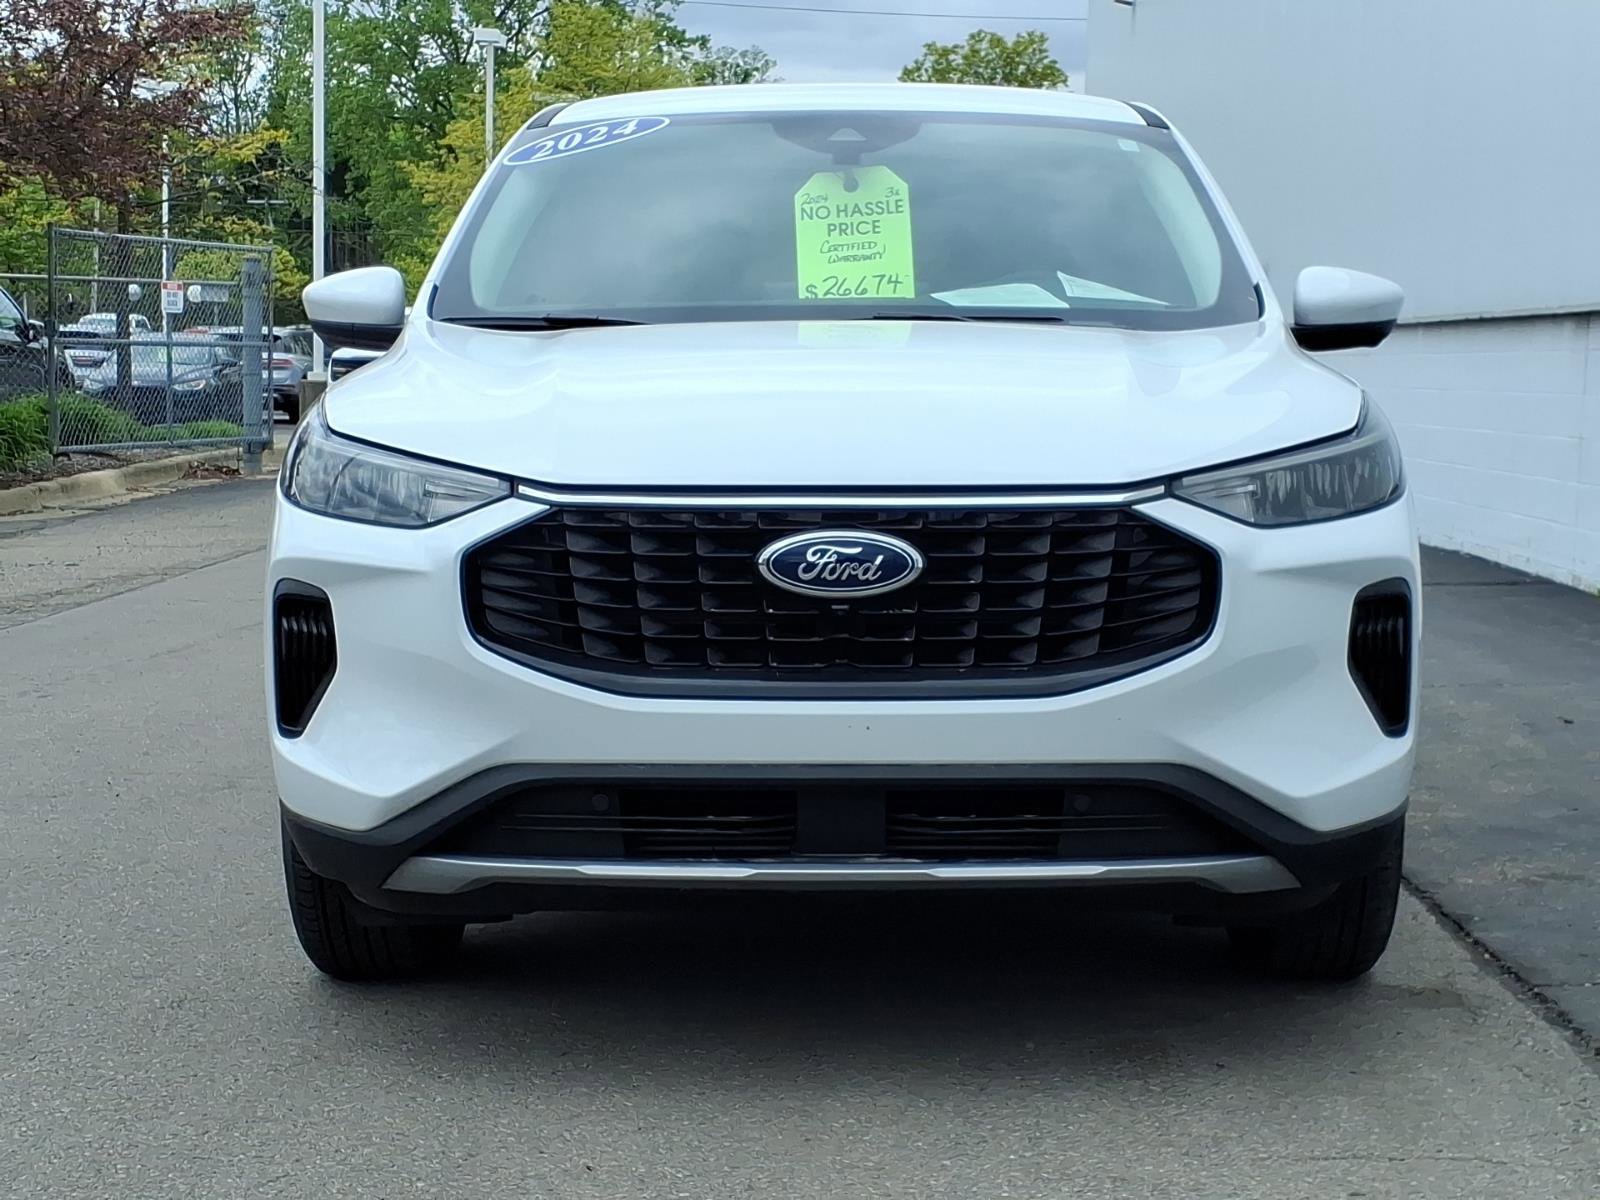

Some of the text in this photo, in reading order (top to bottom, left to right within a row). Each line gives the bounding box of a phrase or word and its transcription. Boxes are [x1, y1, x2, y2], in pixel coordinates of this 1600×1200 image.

[530, 118, 641, 160] 2024
[800, 199, 905, 221] NO HASSLE
[827, 219, 882, 238] PRICE
[797, 545, 884, 581] Ford
